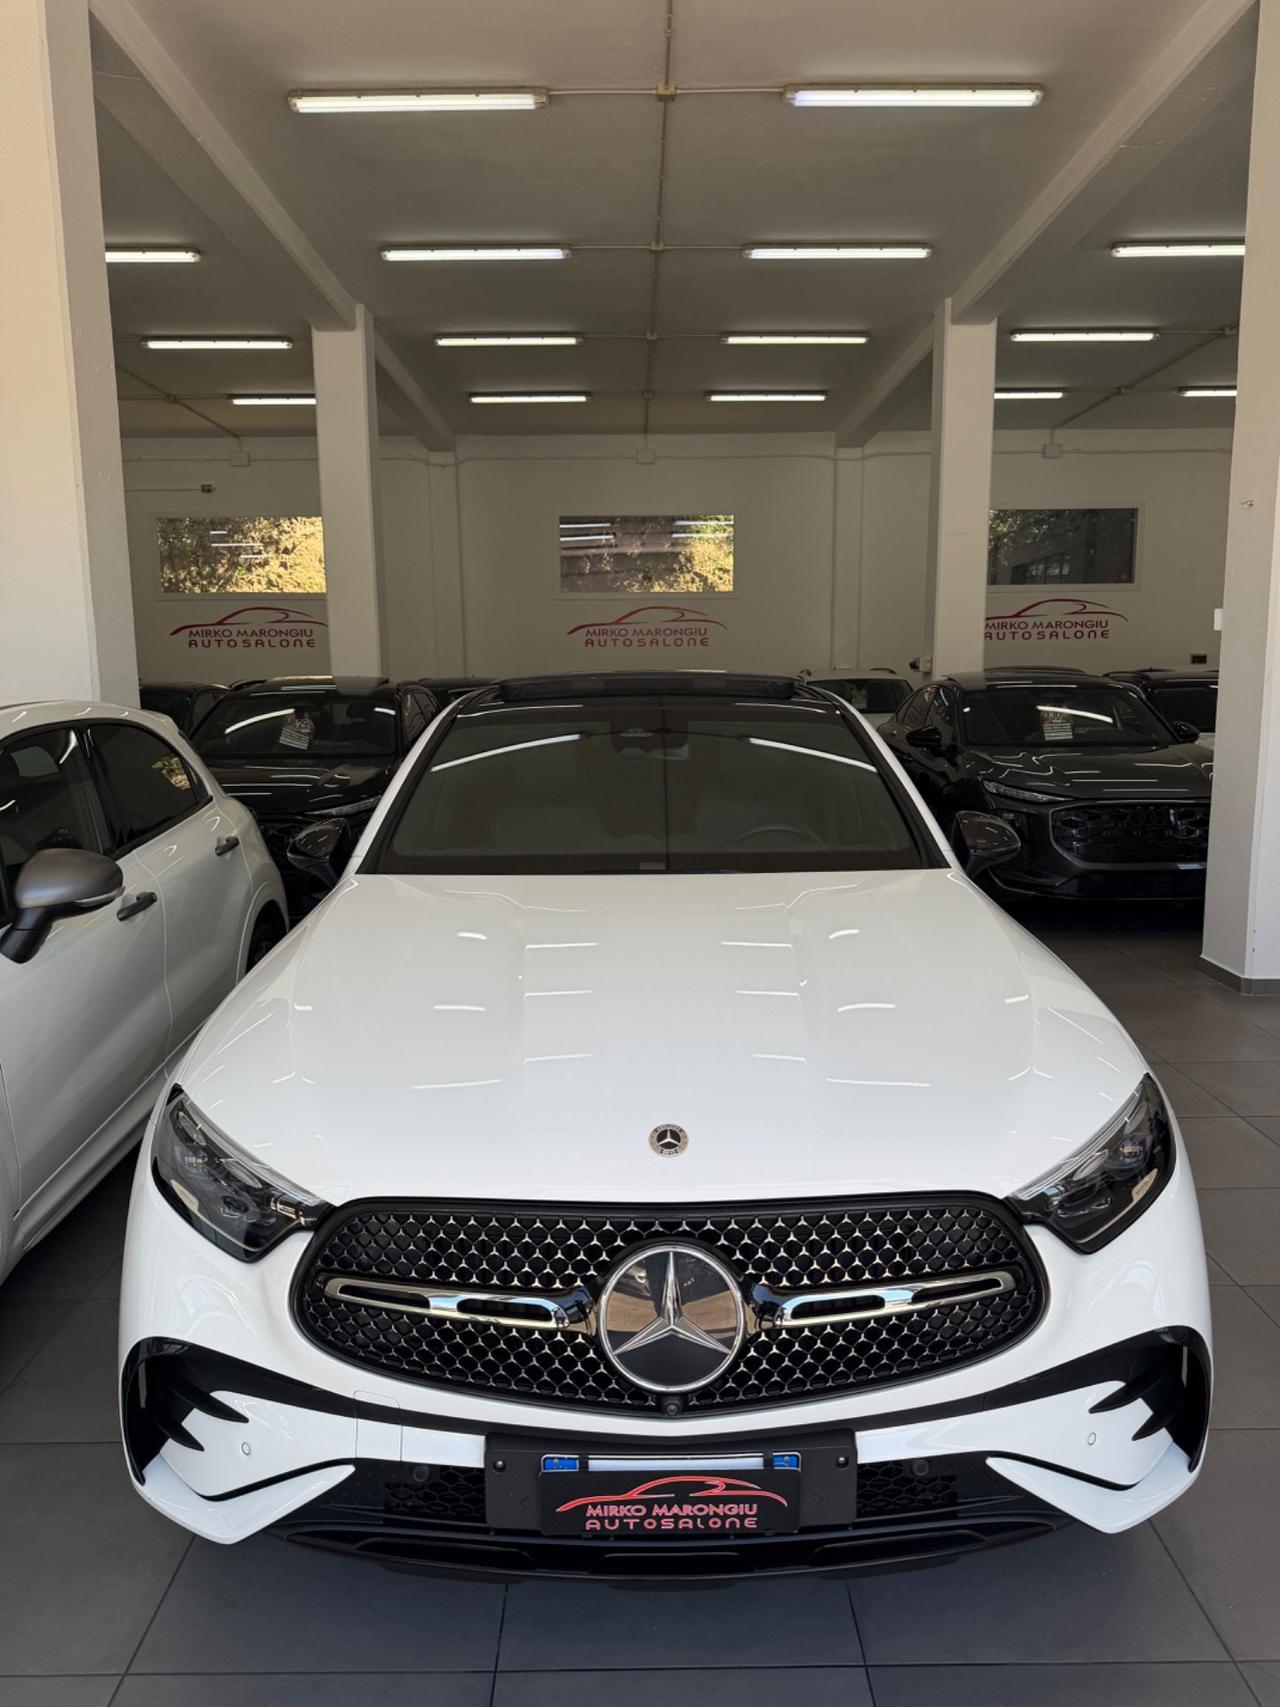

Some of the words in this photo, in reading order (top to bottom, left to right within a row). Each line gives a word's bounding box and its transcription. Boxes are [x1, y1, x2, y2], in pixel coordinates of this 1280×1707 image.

[985, 621, 1029, 630] MIRKO
[1032, 620, 1109, 629] MARONGIU
[189, 629, 232, 638] MIRKO
[236, 628, 313, 638] MARONGIU
[585, 628, 629, 637] MIRKO
[632, 627, 708, 637] MARONGIU
[984, 629, 1110, 640] AUTOSALONE
[188, 639, 316, 648] AUTOSALONE
[585, 637, 709, 647] AUTOSALONE
[585, 1504, 647, 1517] MIRKO
[652, 1503, 758, 1516] MARONGIU
[585, 1517, 758, 1530] AUTOSALONE
